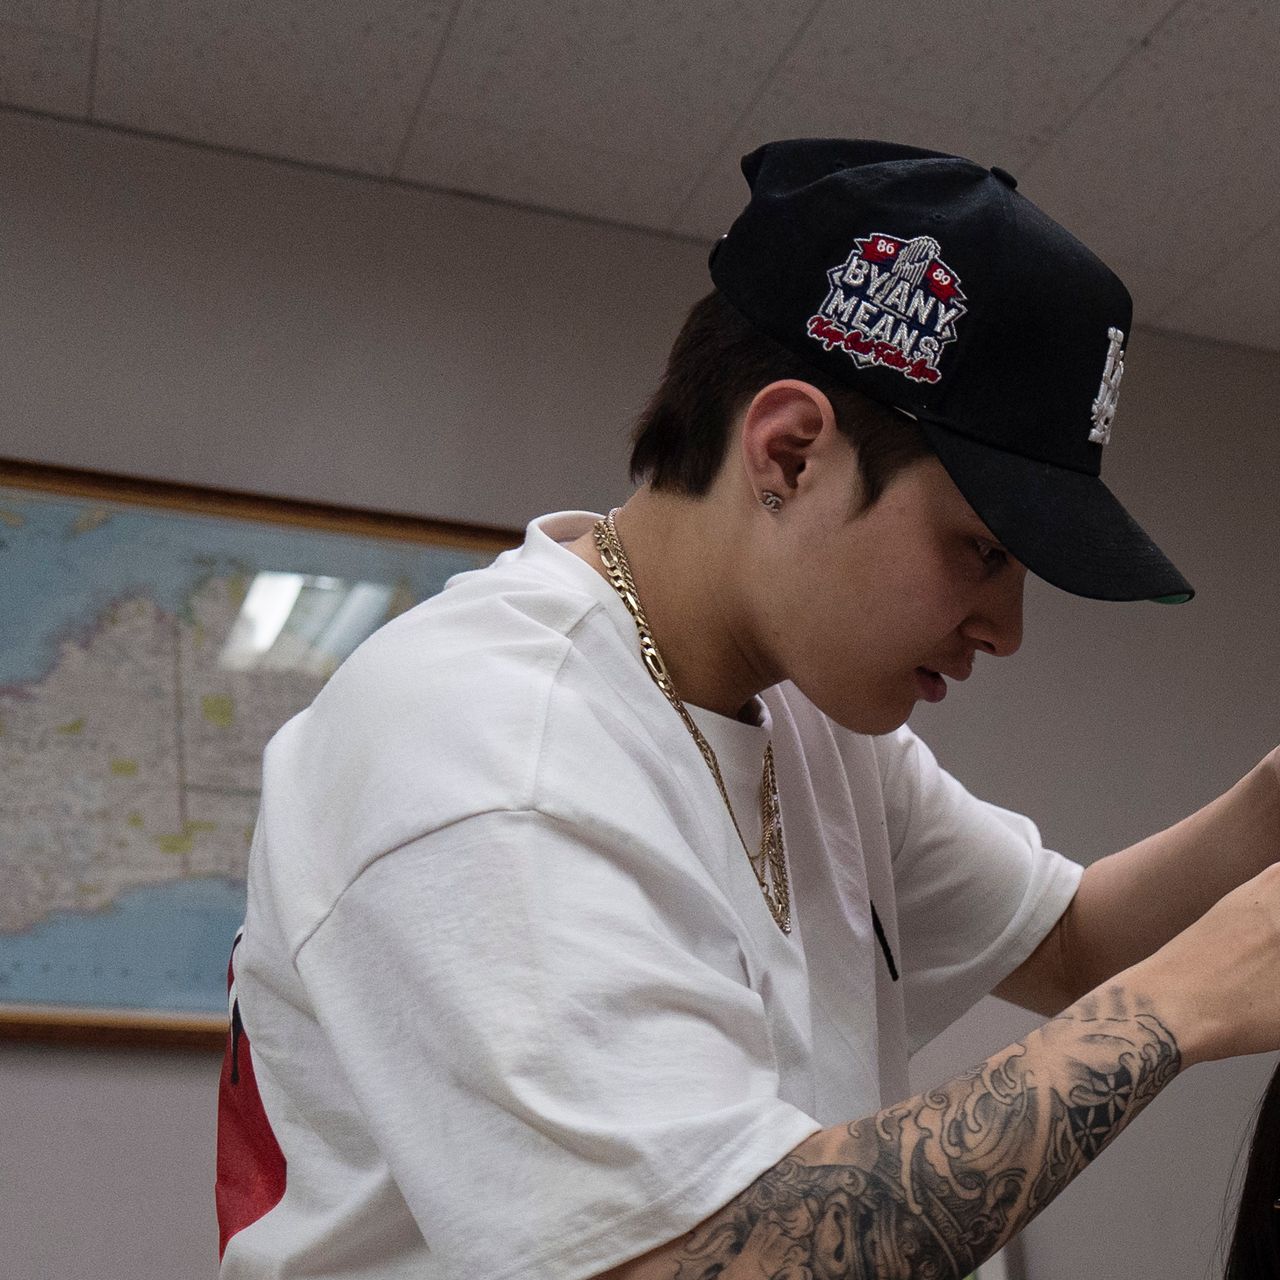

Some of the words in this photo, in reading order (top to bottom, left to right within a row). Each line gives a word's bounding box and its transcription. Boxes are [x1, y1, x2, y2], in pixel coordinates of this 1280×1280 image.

[876, 239, 895, 255] 86
[842, 255, 892, 297] BY
[883, 280, 959, 333] ANY
[932, 268, 951, 286] 89
[825, 287, 940, 366] MEANS
